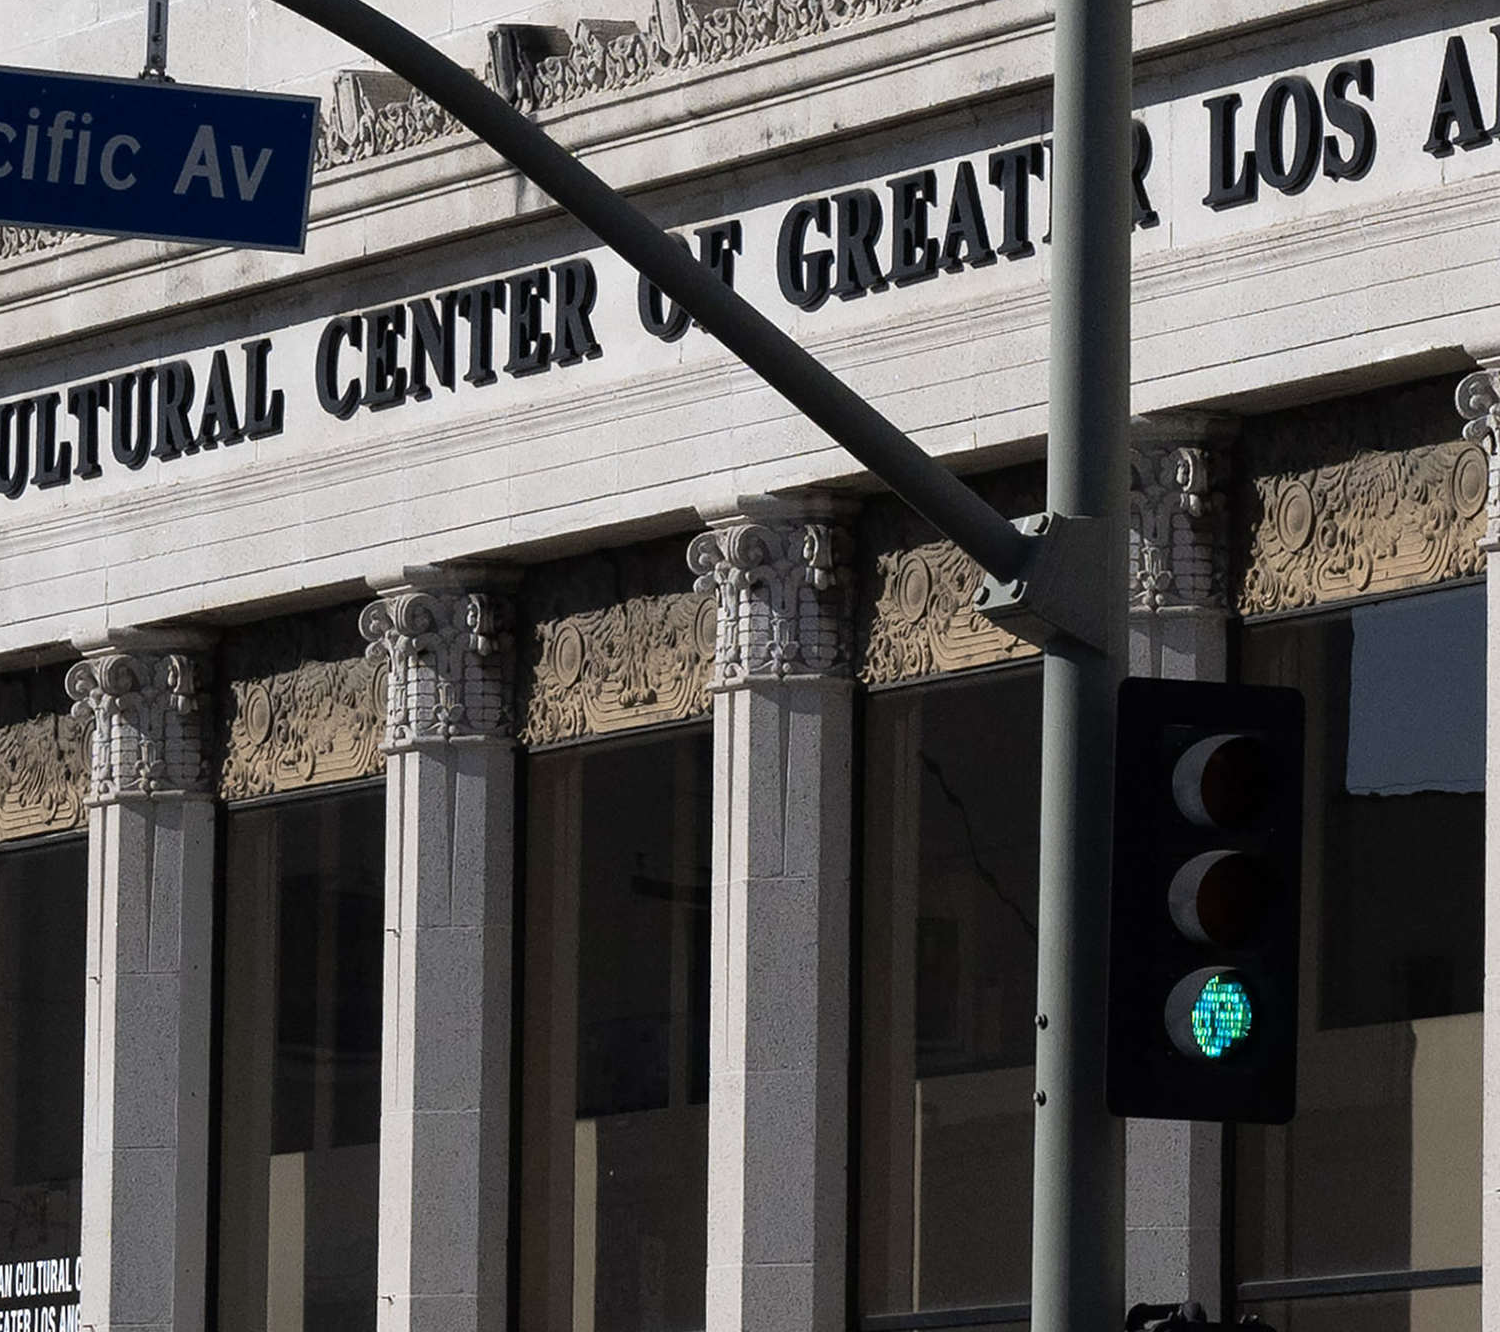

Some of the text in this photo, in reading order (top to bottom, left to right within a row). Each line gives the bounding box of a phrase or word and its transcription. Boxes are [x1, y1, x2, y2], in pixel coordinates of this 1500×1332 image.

[172, 123, 273, 202] Av
[315, 257, 603, 422] CENTER
[776, 109, 1161, 313] GREATR
[1202, 58, 1377, 213] LOS
[15, 1258, 72, 1297] CULTURAL
